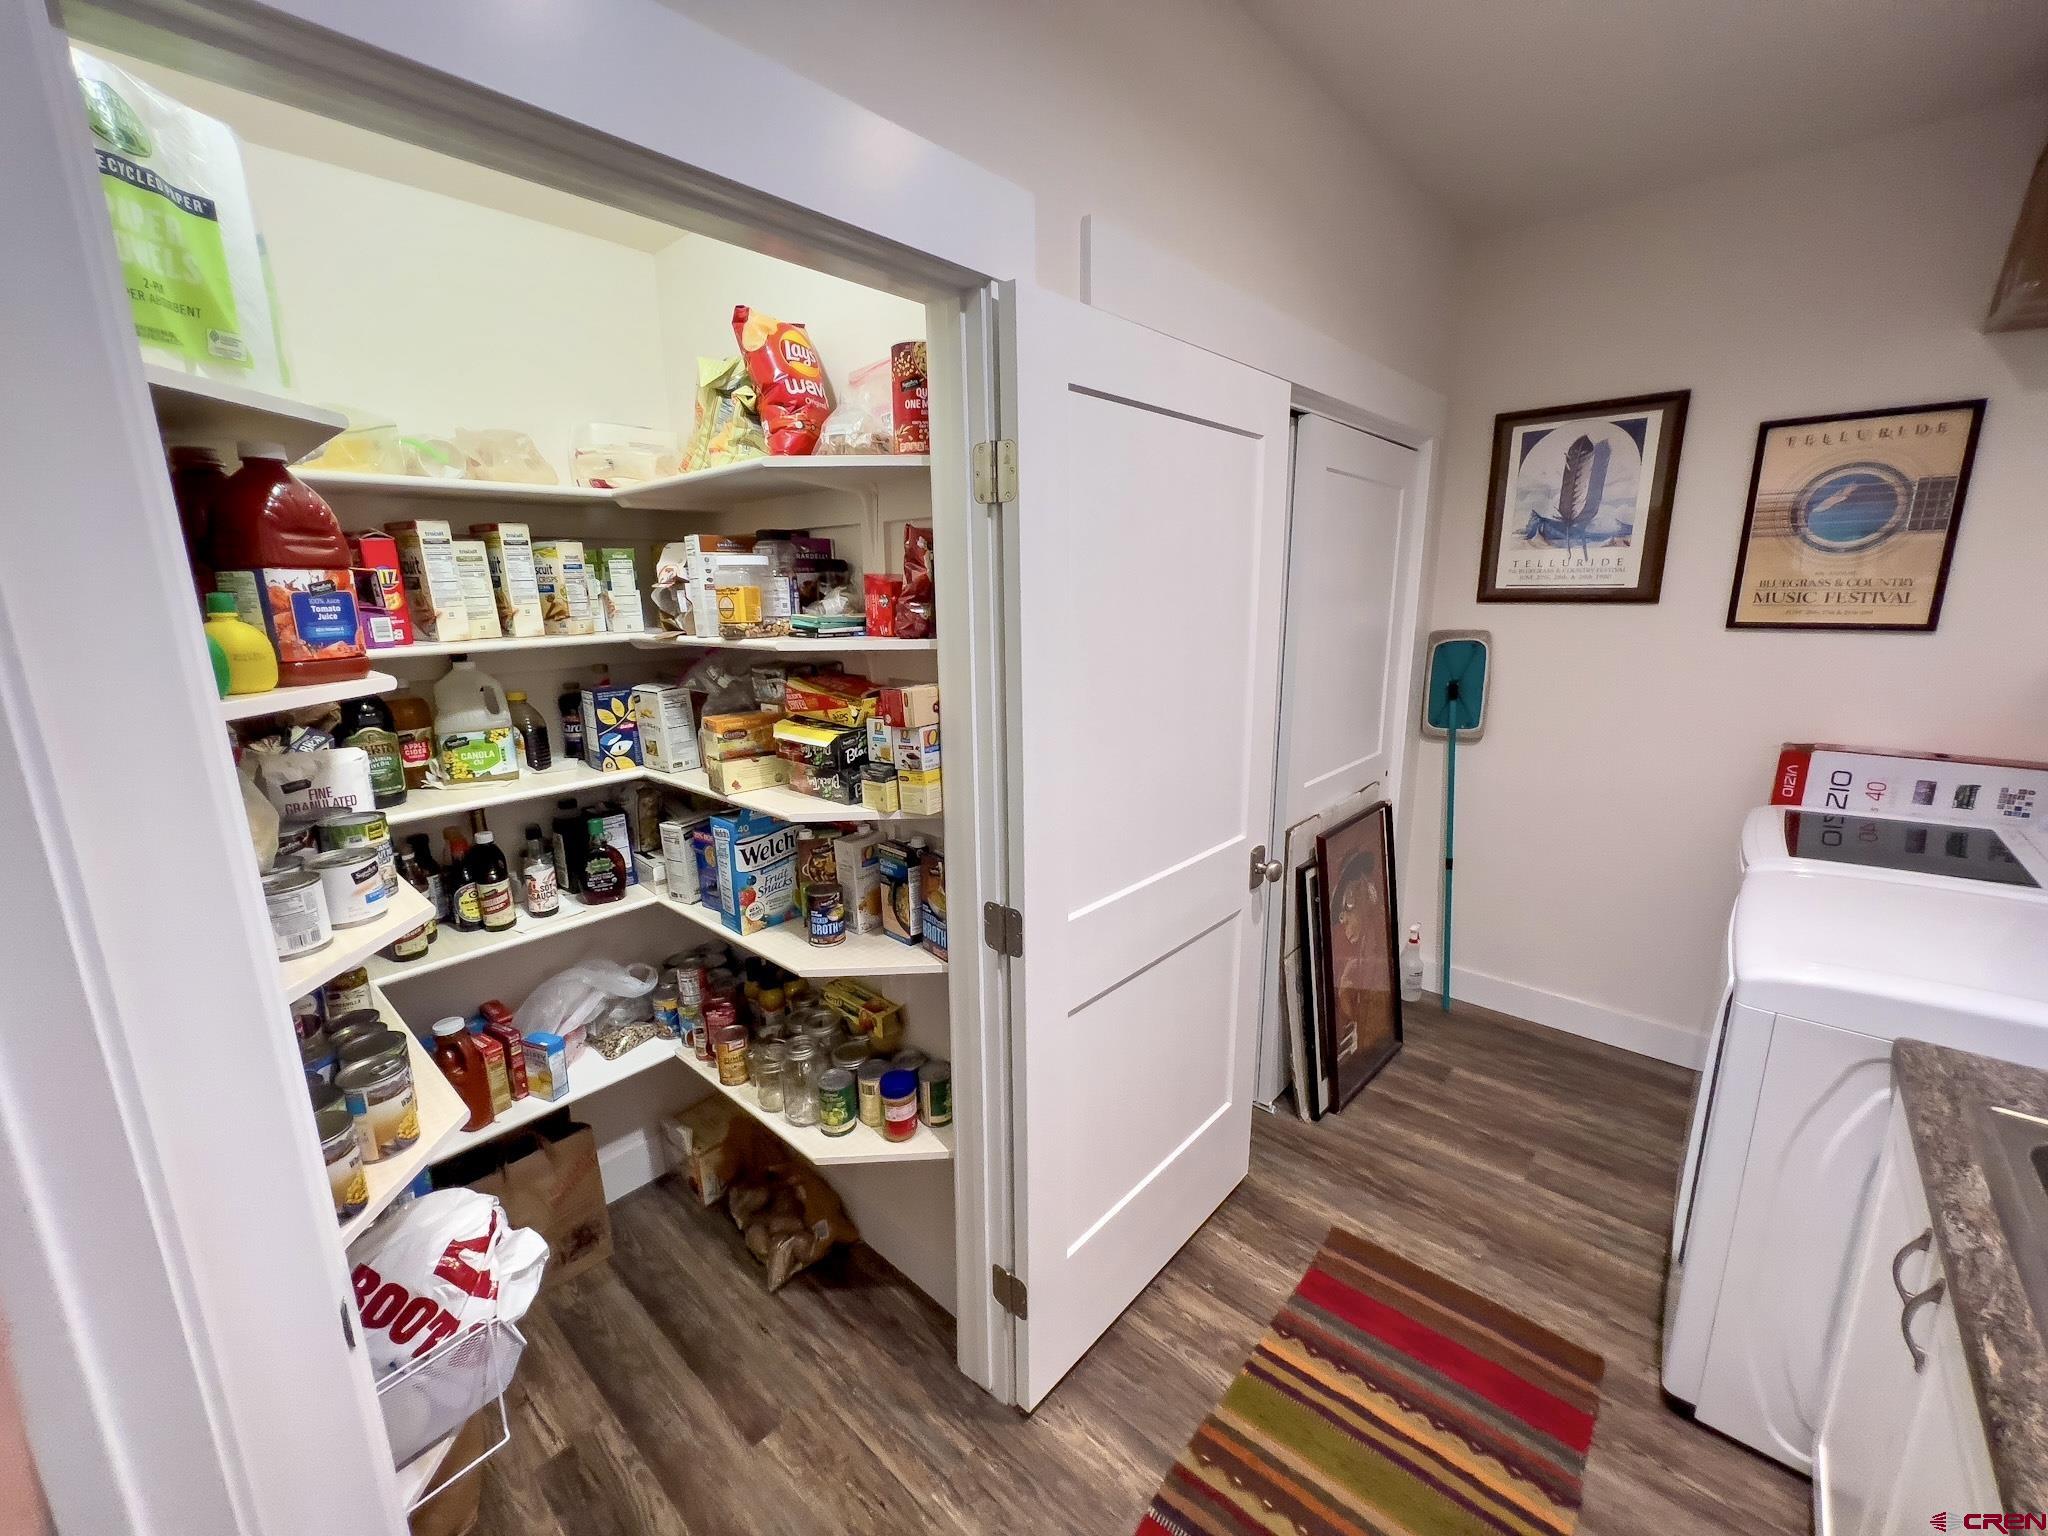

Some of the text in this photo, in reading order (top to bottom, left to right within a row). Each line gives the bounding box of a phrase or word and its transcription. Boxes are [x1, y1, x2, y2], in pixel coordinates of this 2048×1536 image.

[904, 400, 921, 409] ONE
[1786, 421, 1950, 446] TELLURIDE
[1513, 558, 1624, 568] TELLURIDE
[1759, 579, 1831, 588] BLUEGRASS
[1752, 592, 1917, 604] MUSIC FESTIVAL
[310, 605, 342, 613] Tomato
[317, 612, 339, 621] Juice
[403, 741, 428, 750] APPLE
[460, 750, 496, 761] CANOLA
[1782, 764, 1800, 797] VIZIO
[308, 786, 333, 801] FINE
[1865, 781, 1887, 801] 40
[284, 794, 358, 815] GRANULATED
[757, 876, 793, 899] Snacks
